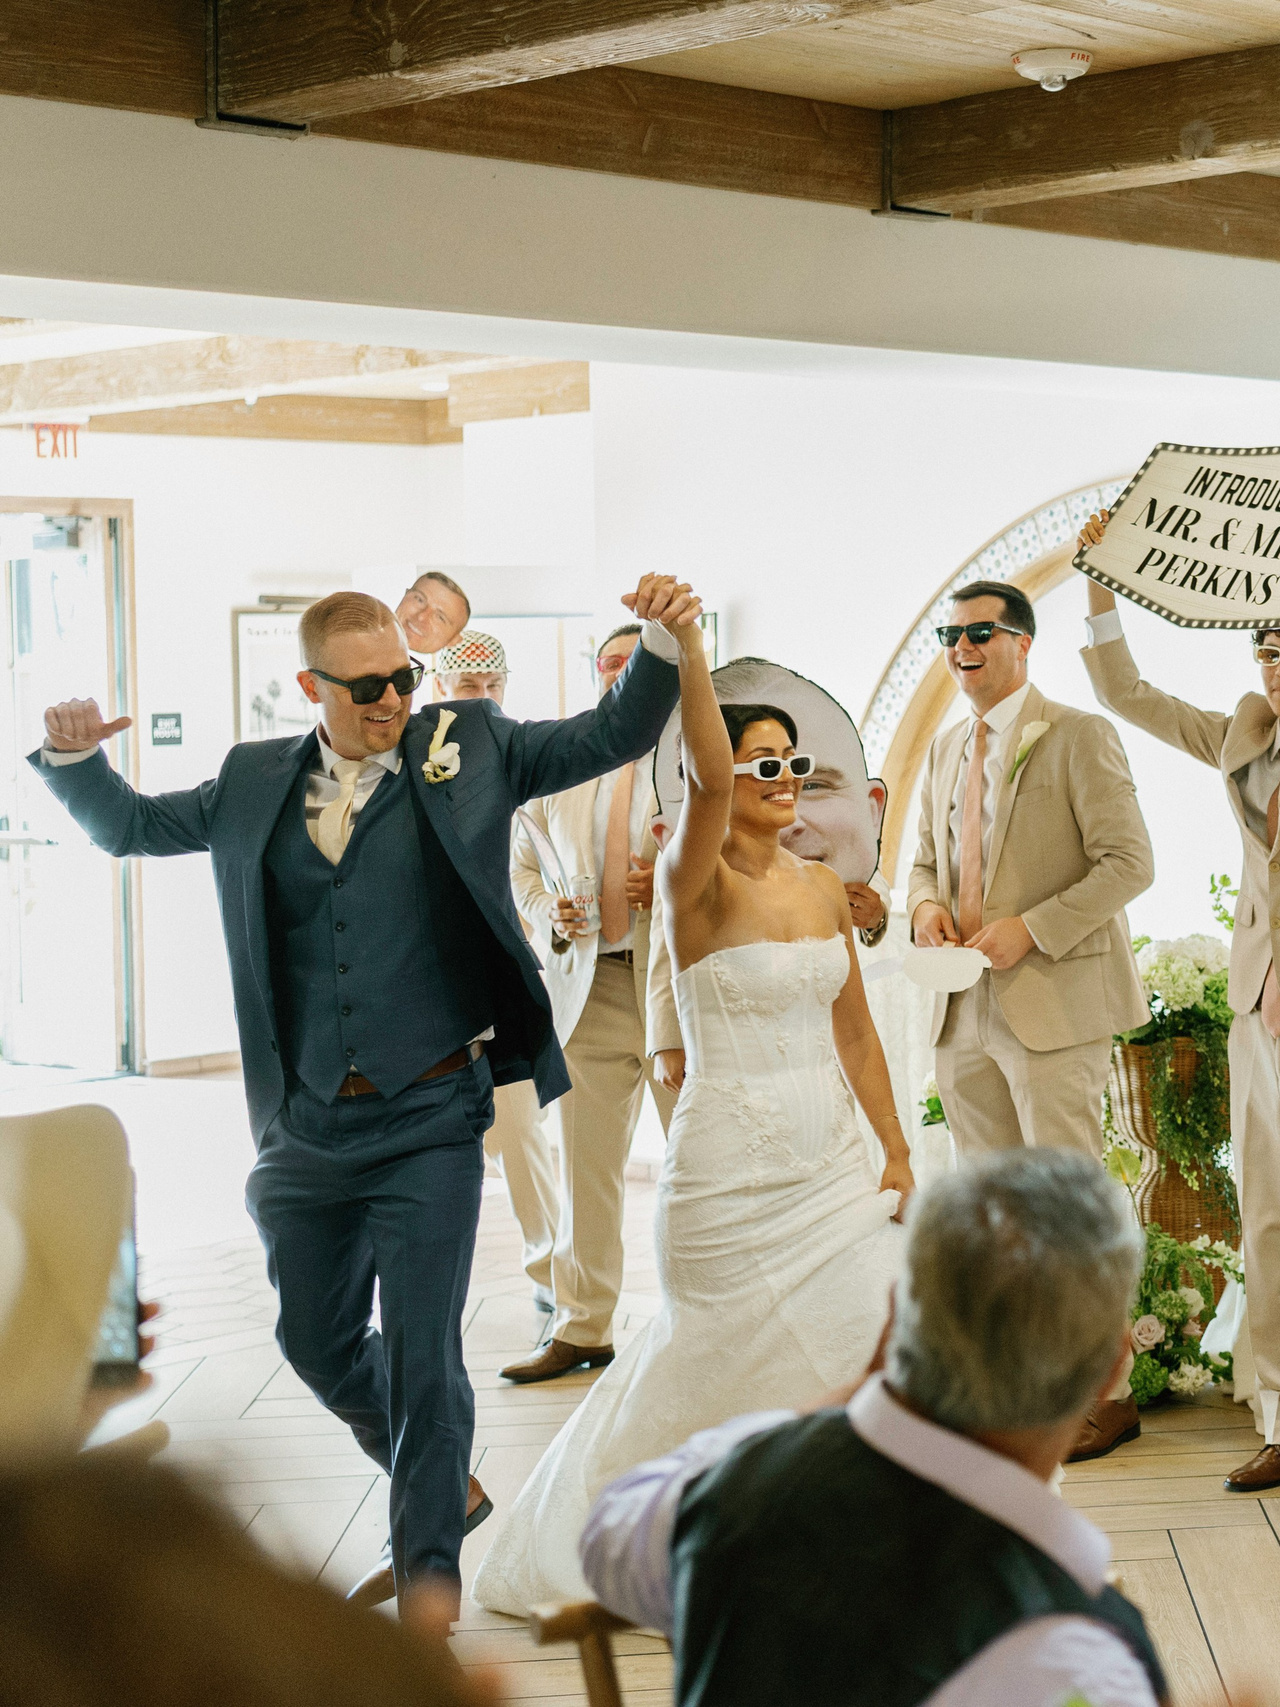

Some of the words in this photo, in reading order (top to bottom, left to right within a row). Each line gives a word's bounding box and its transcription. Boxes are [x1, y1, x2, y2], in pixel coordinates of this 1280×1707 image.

[1070, 52, 1090, 63] FIRE
[33, 425, 80, 458] EXIT
[1131, 497, 1202, 543] MR.
[1210, 518, 1242, 551] &
[1134, 547, 1280, 605] PERKINS
